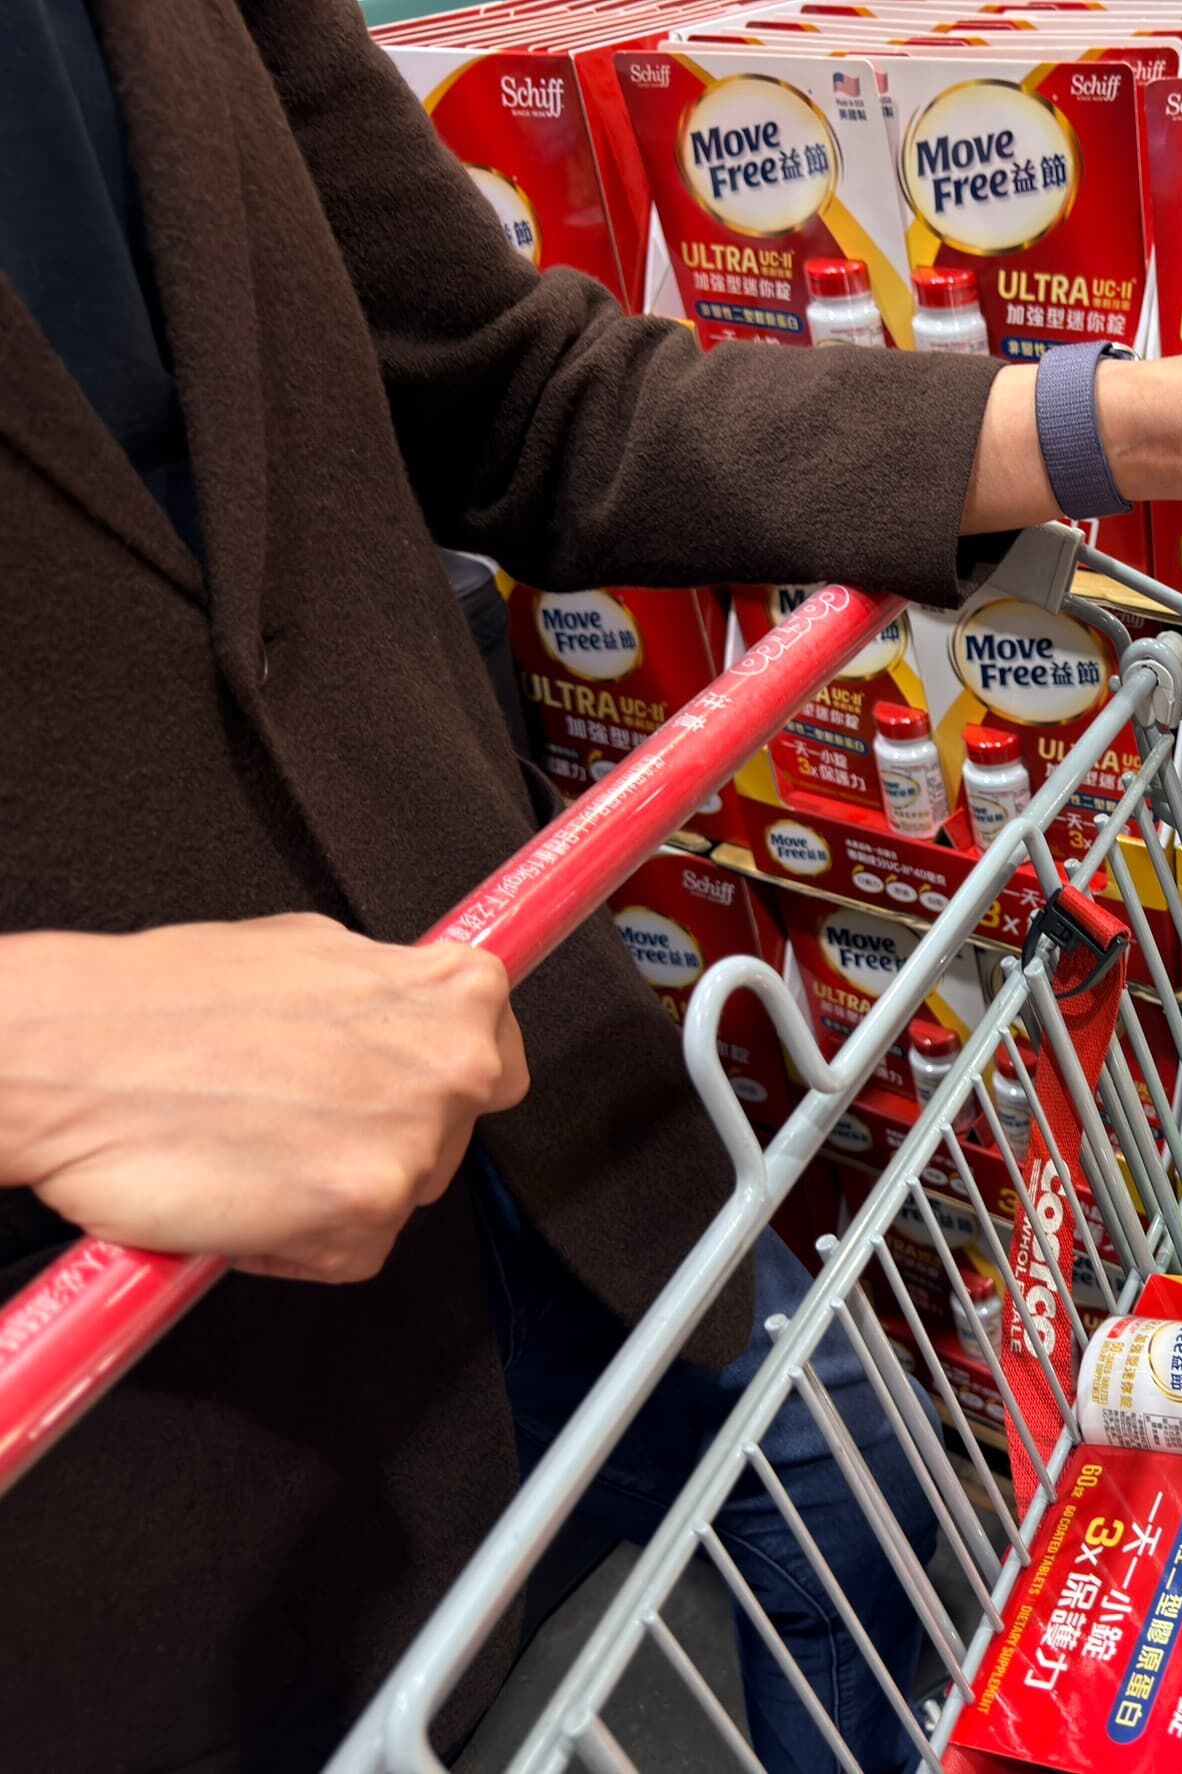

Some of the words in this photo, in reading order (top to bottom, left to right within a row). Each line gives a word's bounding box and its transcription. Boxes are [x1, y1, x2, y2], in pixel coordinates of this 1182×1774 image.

[630, 64, 671, 87] Schiff
[1070, 74, 1122, 102] Schiff
[501, 77, 564, 117] Schiff
[691, 120, 780, 167] Move
[916, 129, 1014, 178] Move
[710, 158, 776, 198] Free
[780, 143, 829, 181] 益節
[932, 172, 1009, 214] Free
[1012, 153, 1067, 195] 益節
[681, 242, 759, 274] ULTRA
[998, 269, 1090, 307] ULTRA
[542, 609, 601, 630] Move
[555, 631, 600, 653] Free
[965, 634, 1054, 660] Move
[980, 663, 1048, 690] Free
[1051, 660, 1100, 687] 益節
[526, 674, 621, 724] ULTRA
[770, 832, 808, 849] Move
[682, 869, 736, 906] Schiff
[619, 927, 669, 948] Move
[827, 926, 895, 951] Move
[841, 949, 893, 972] Free
[1064, 1505, 1077, 1521] 60
[1048, 1519, 1075, 1557] COATED
[1075, 1516, 1125, 1566] 3x
[1029, 1555, 1058, 1596] TABLETS
[1082, 1491, 1163, 1662] 一天一小錠
[1010, 1604, 1033, 1645] DIETARY
[1025, 1573, 1103, 1691] 保護力
[978, 1642, 1016, 1715] SUPPLEMENT
